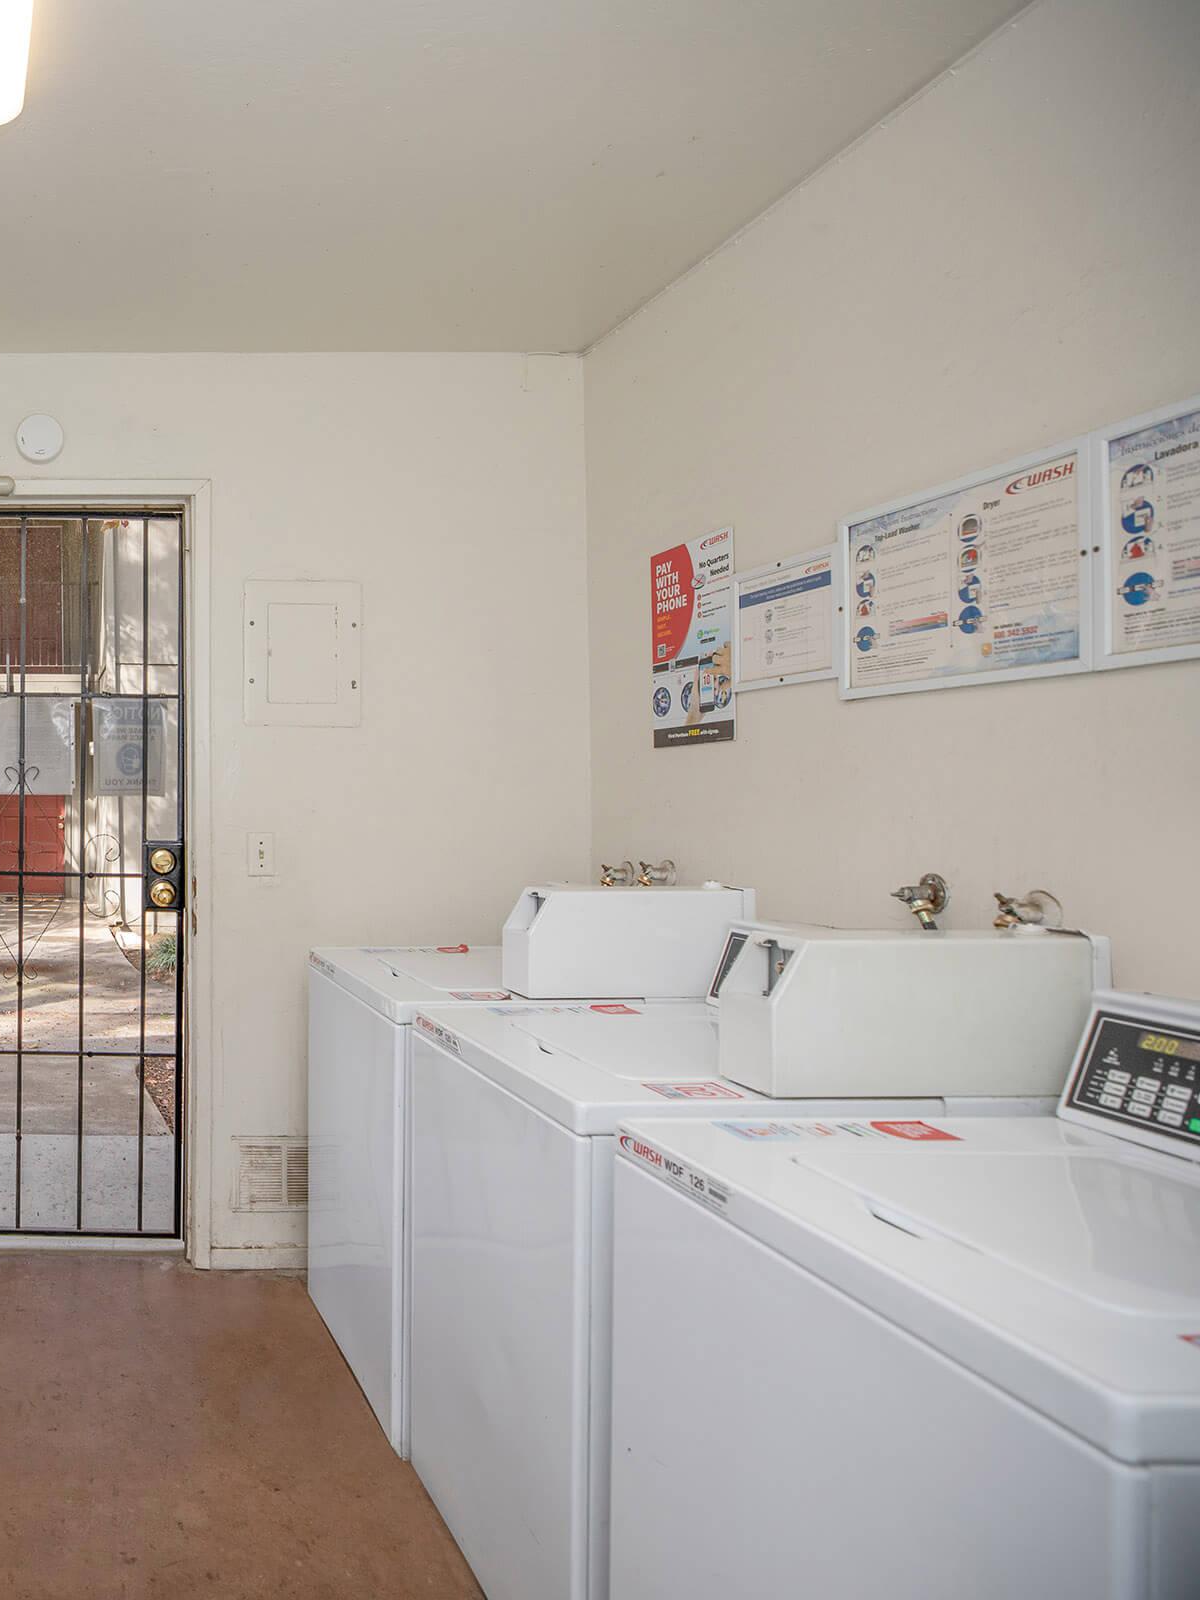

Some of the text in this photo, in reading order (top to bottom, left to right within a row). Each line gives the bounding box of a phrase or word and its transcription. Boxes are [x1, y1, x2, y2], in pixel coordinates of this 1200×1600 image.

[1154, 440, 1199, 461] Lavadora
[1026, 461, 1075, 487] WASH
[983, 499, 1001, 511] Dryer
[708, 531, 729, 546] WASH
[655, 560, 673, 577] PAY
[699, 553, 729, 569] No Quarters
[710, 563, 729, 577] Needed
[655, 571, 680, 590] WITH
[655, 583, 681, 602] YOUR
[656, 594, 688, 615] PHONE
[632, 1140, 705, 1192] WASH WDF 126
